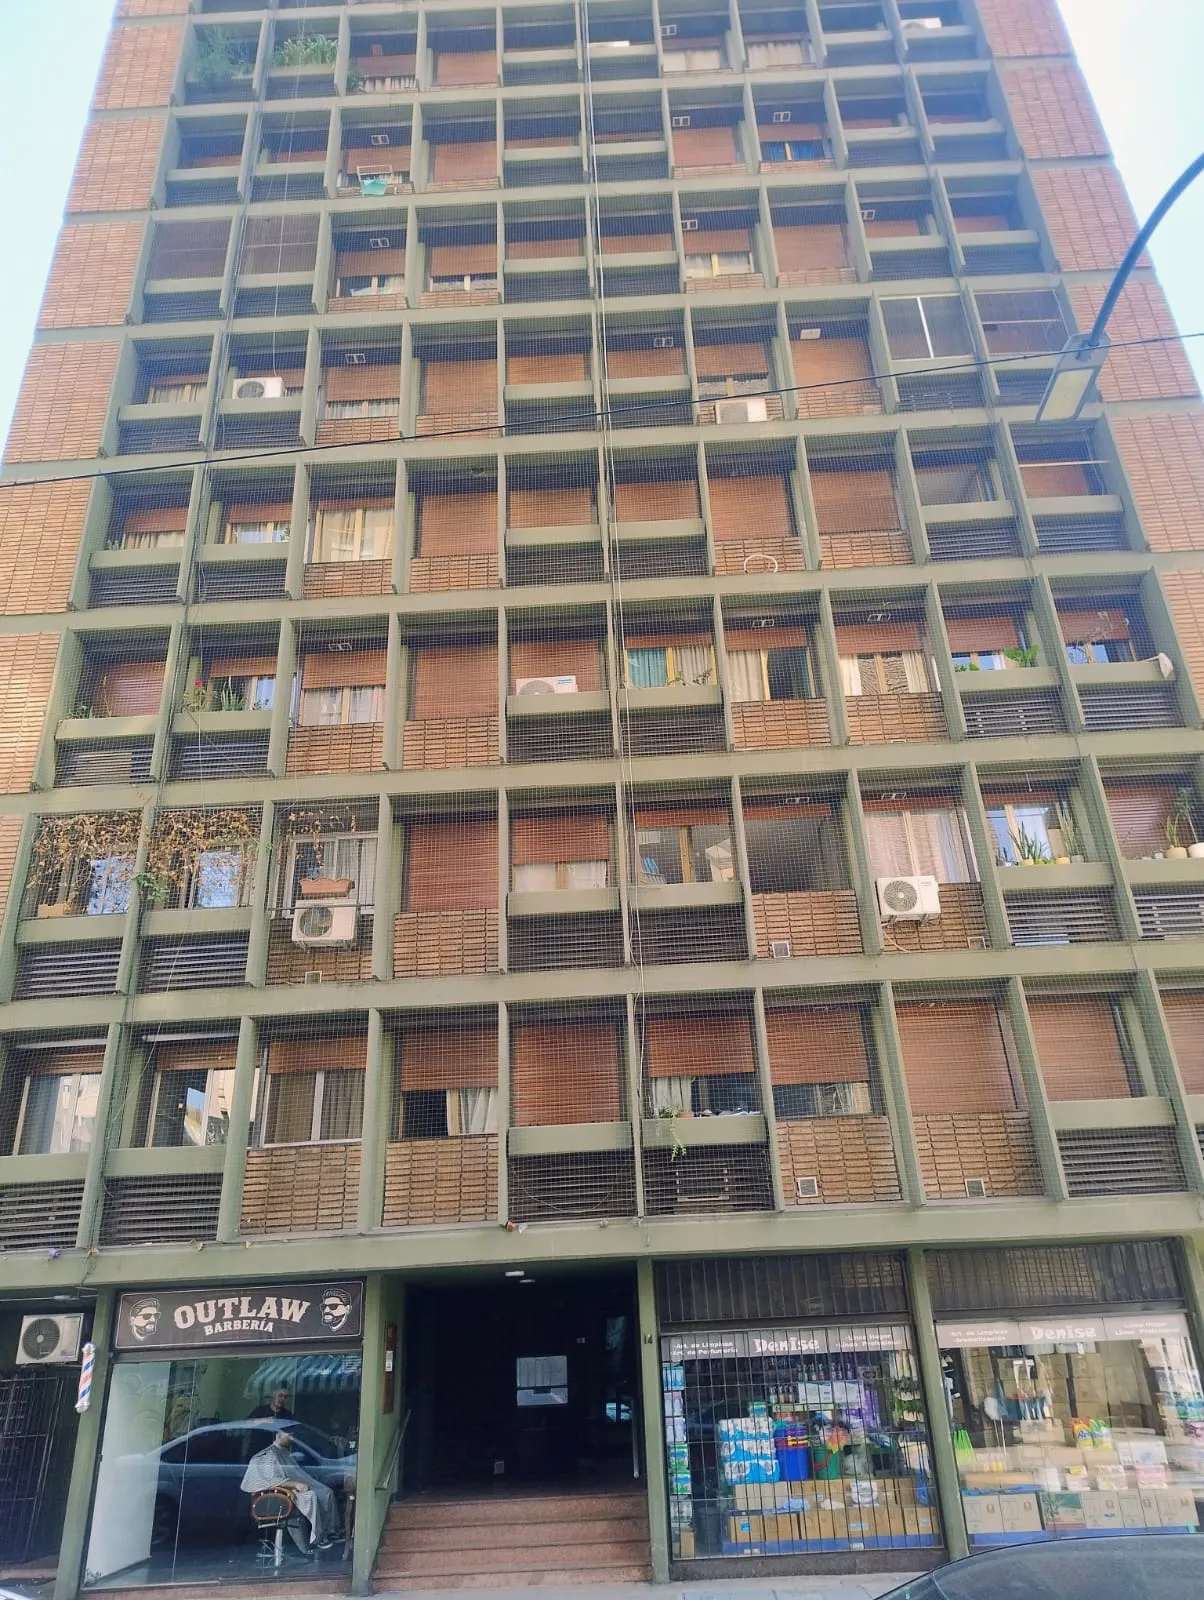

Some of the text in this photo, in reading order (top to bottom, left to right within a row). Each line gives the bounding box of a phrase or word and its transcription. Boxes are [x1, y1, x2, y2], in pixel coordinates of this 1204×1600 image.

[174, 1297, 311, 1329] OUTLAW
[204, 1319, 274, 1336] BARBERÍA
[1030, 1325, 1097, 1340] Denise
[753, 1337, 820, 1353] Denise
